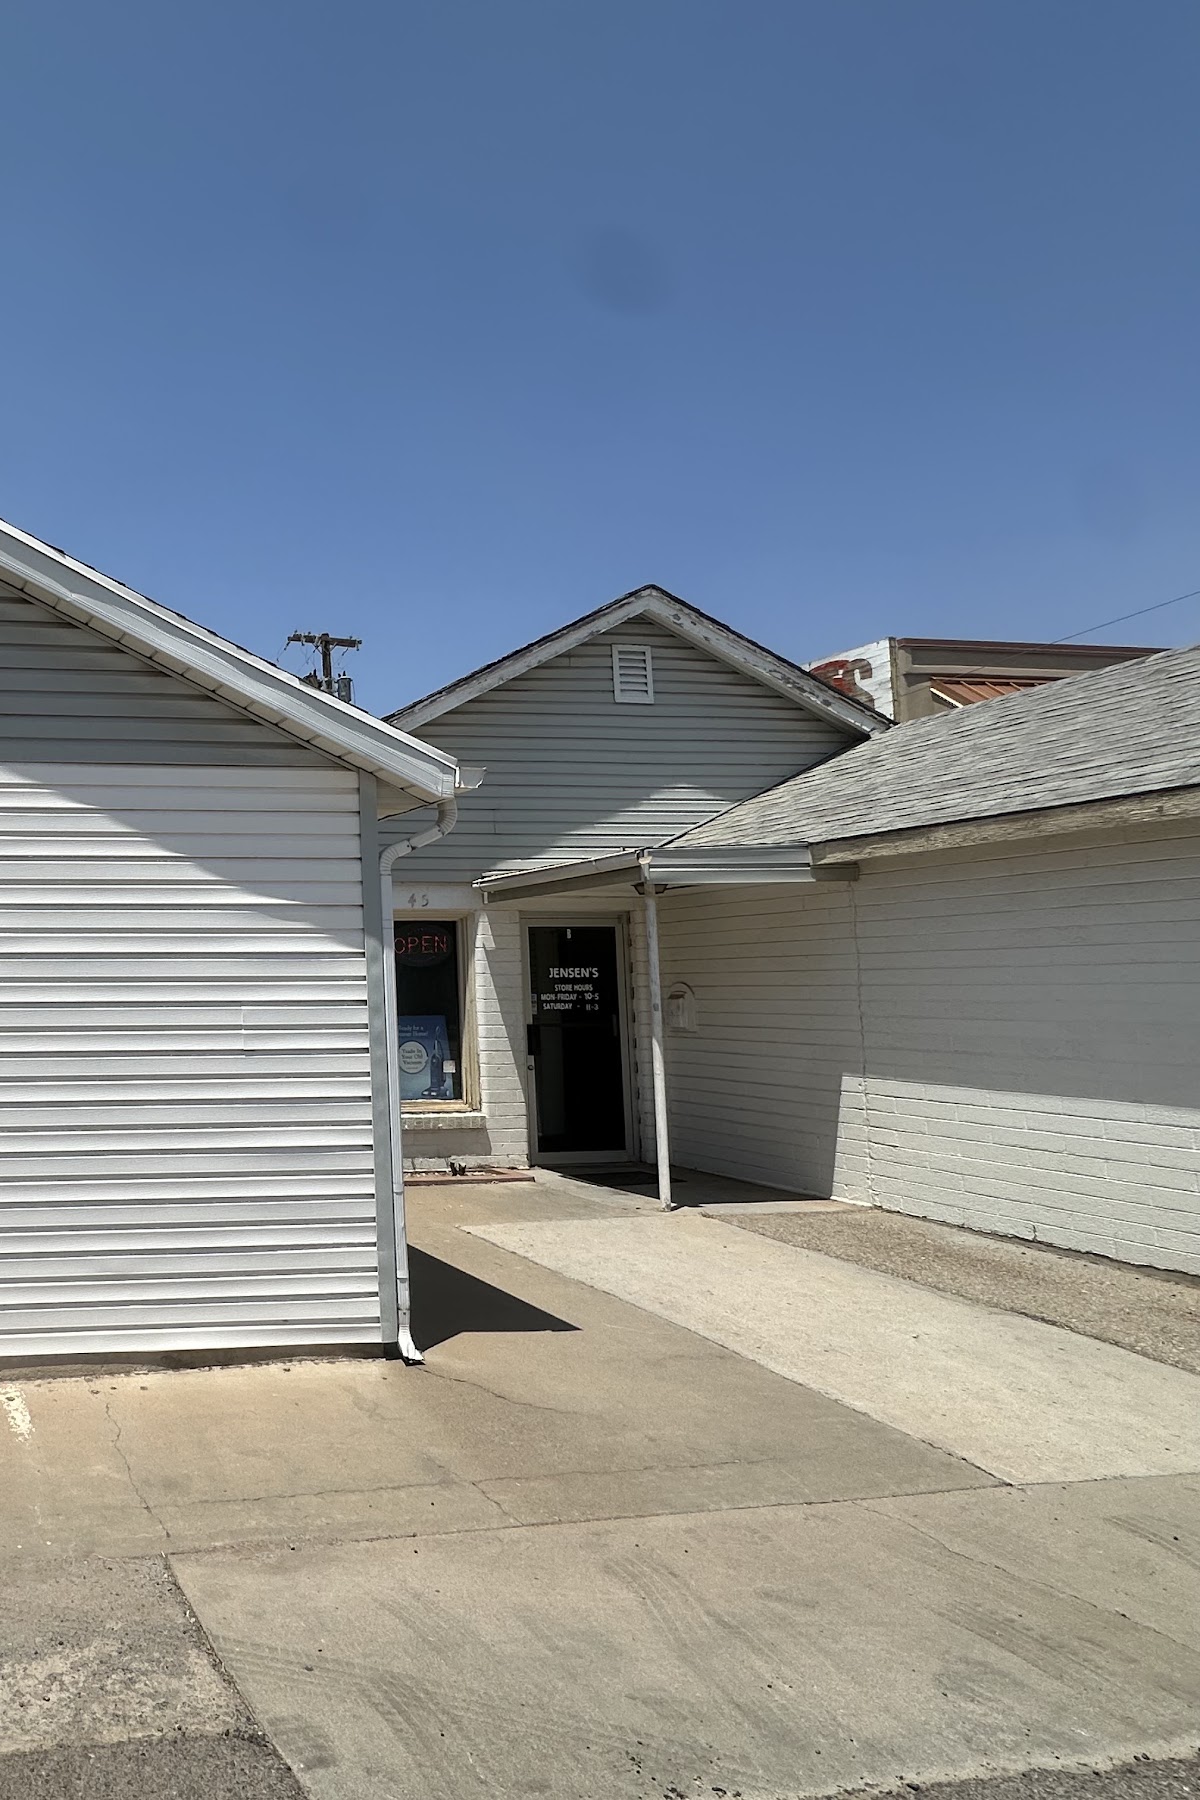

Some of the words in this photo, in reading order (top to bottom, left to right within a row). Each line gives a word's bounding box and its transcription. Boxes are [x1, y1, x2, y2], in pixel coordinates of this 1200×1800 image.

[408, 893, 429, 908] 45
[394, 936, 447, 954] OPEN
[549, 967, 599, 978] JENSEN'S
